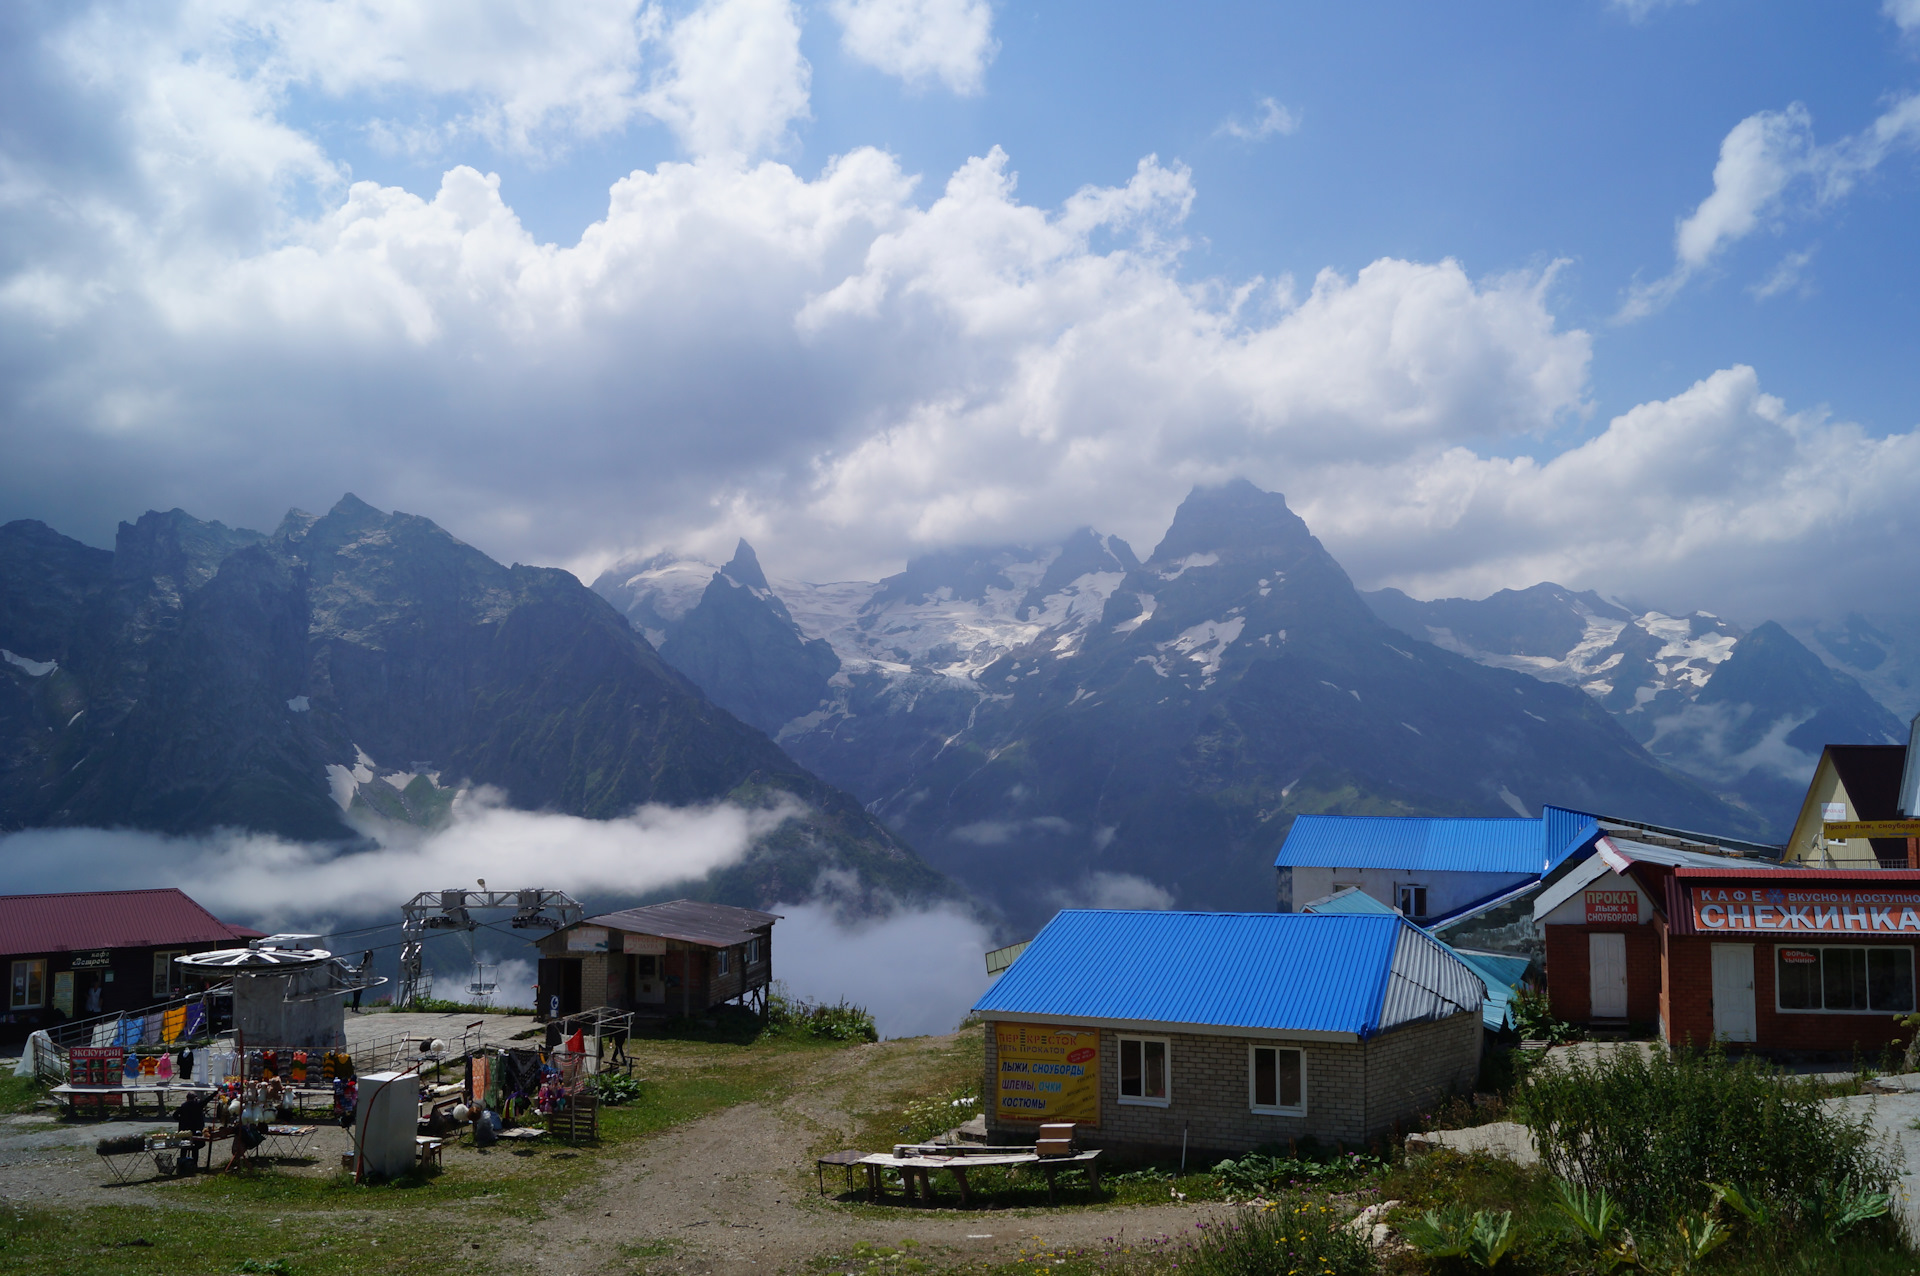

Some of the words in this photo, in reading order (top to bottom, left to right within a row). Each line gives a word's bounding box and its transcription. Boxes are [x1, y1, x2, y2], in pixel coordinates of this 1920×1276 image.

[1878, 822, 1920, 830] сноубордо
[1586, 892, 1637, 904] ПРОКАТ
[1700, 889, 1763, 902] КАФЕ
[1788, 893, 1838, 902] ВКУСНО
[1842, 893, 1851, 902] И
[1853, 893, 1920, 904] ДОСТУПНО
[1587, 913, 1637, 923] СНОУБОРДОВ
[1700, 904, 1920, 930] СНЕЖИНКА
[72, 957, 110, 967] Встреча
[72, 1048, 121, 1057] ЭКСКУРСИИ
[1019, 1044, 1065, 1054] ПРОКАТОВ
[1001, 1062, 1030, 1075] ЛЫЖИ,
[1032, 1063, 1085, 1077] СНОУБОРДЫ
[1001, 1079, 1036, 1092] ШЛЕМЫ,
[1038, 1081, 1062, 1092] ОЧКИ
[1001, 1097, 1046, 1109] КОСТЮМЫ
